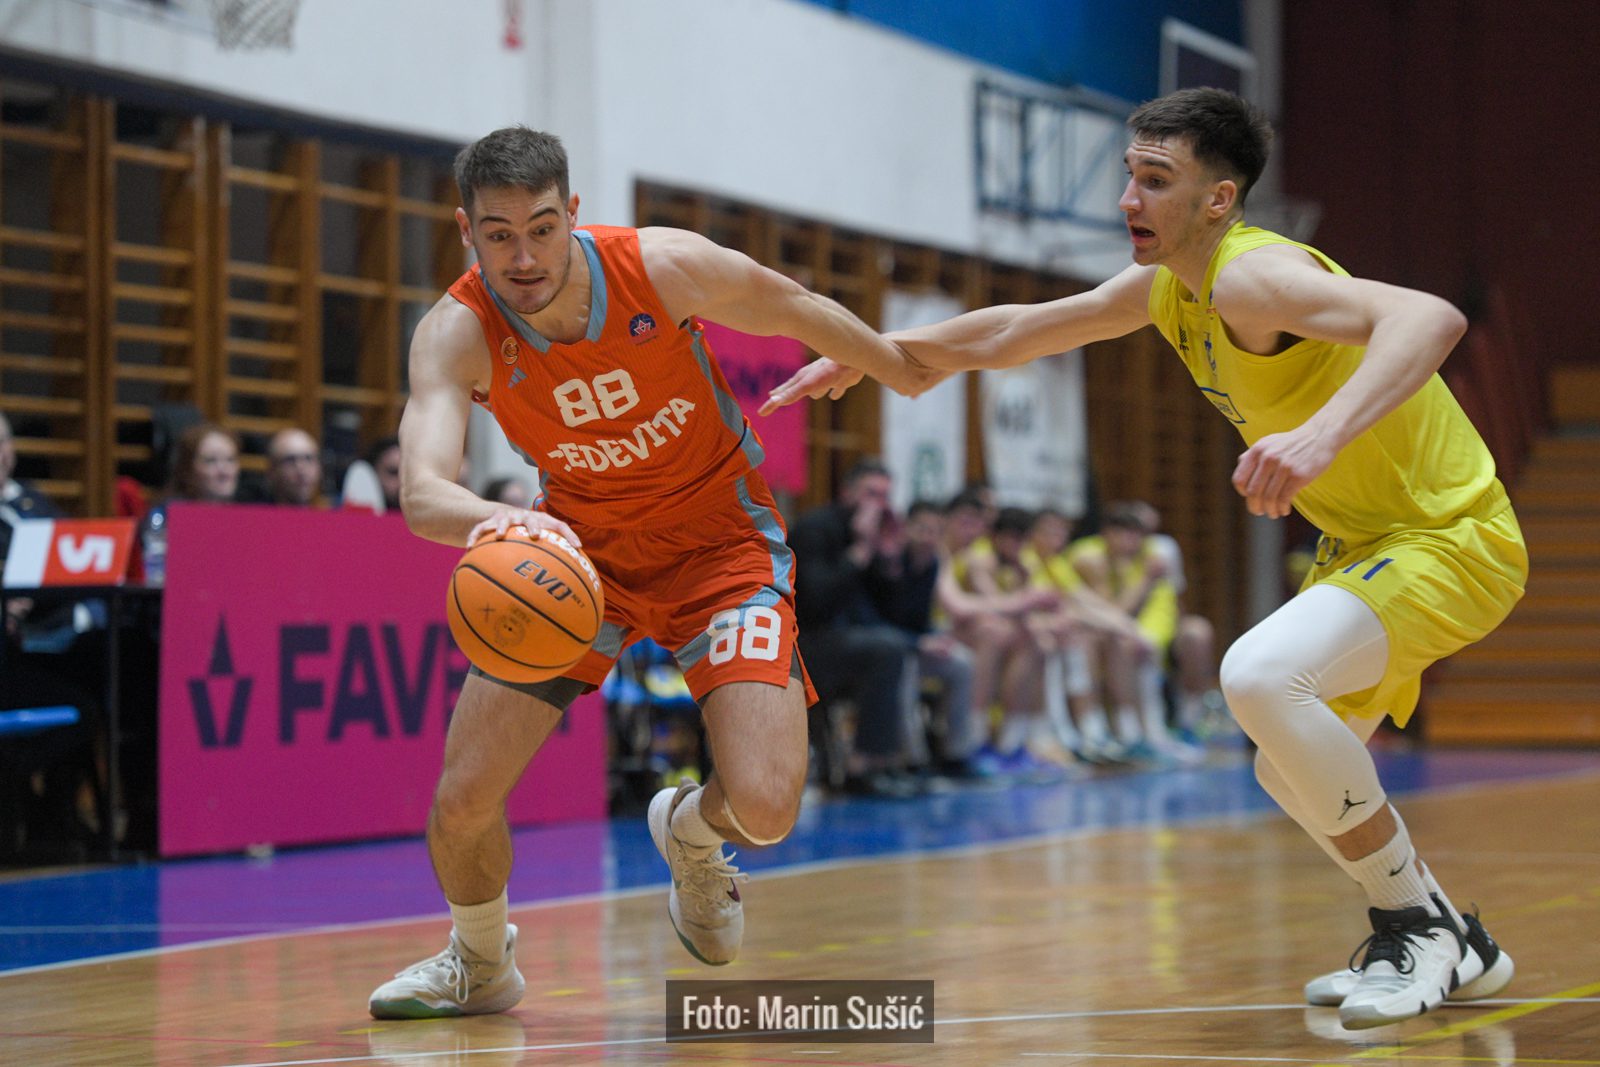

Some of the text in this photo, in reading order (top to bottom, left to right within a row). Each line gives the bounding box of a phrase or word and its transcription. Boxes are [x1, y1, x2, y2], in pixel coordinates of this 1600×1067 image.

[553, 368, 640, 428] 88
[513, 559, 572, 602] EVO
[708, 606, 782, 666] 88
